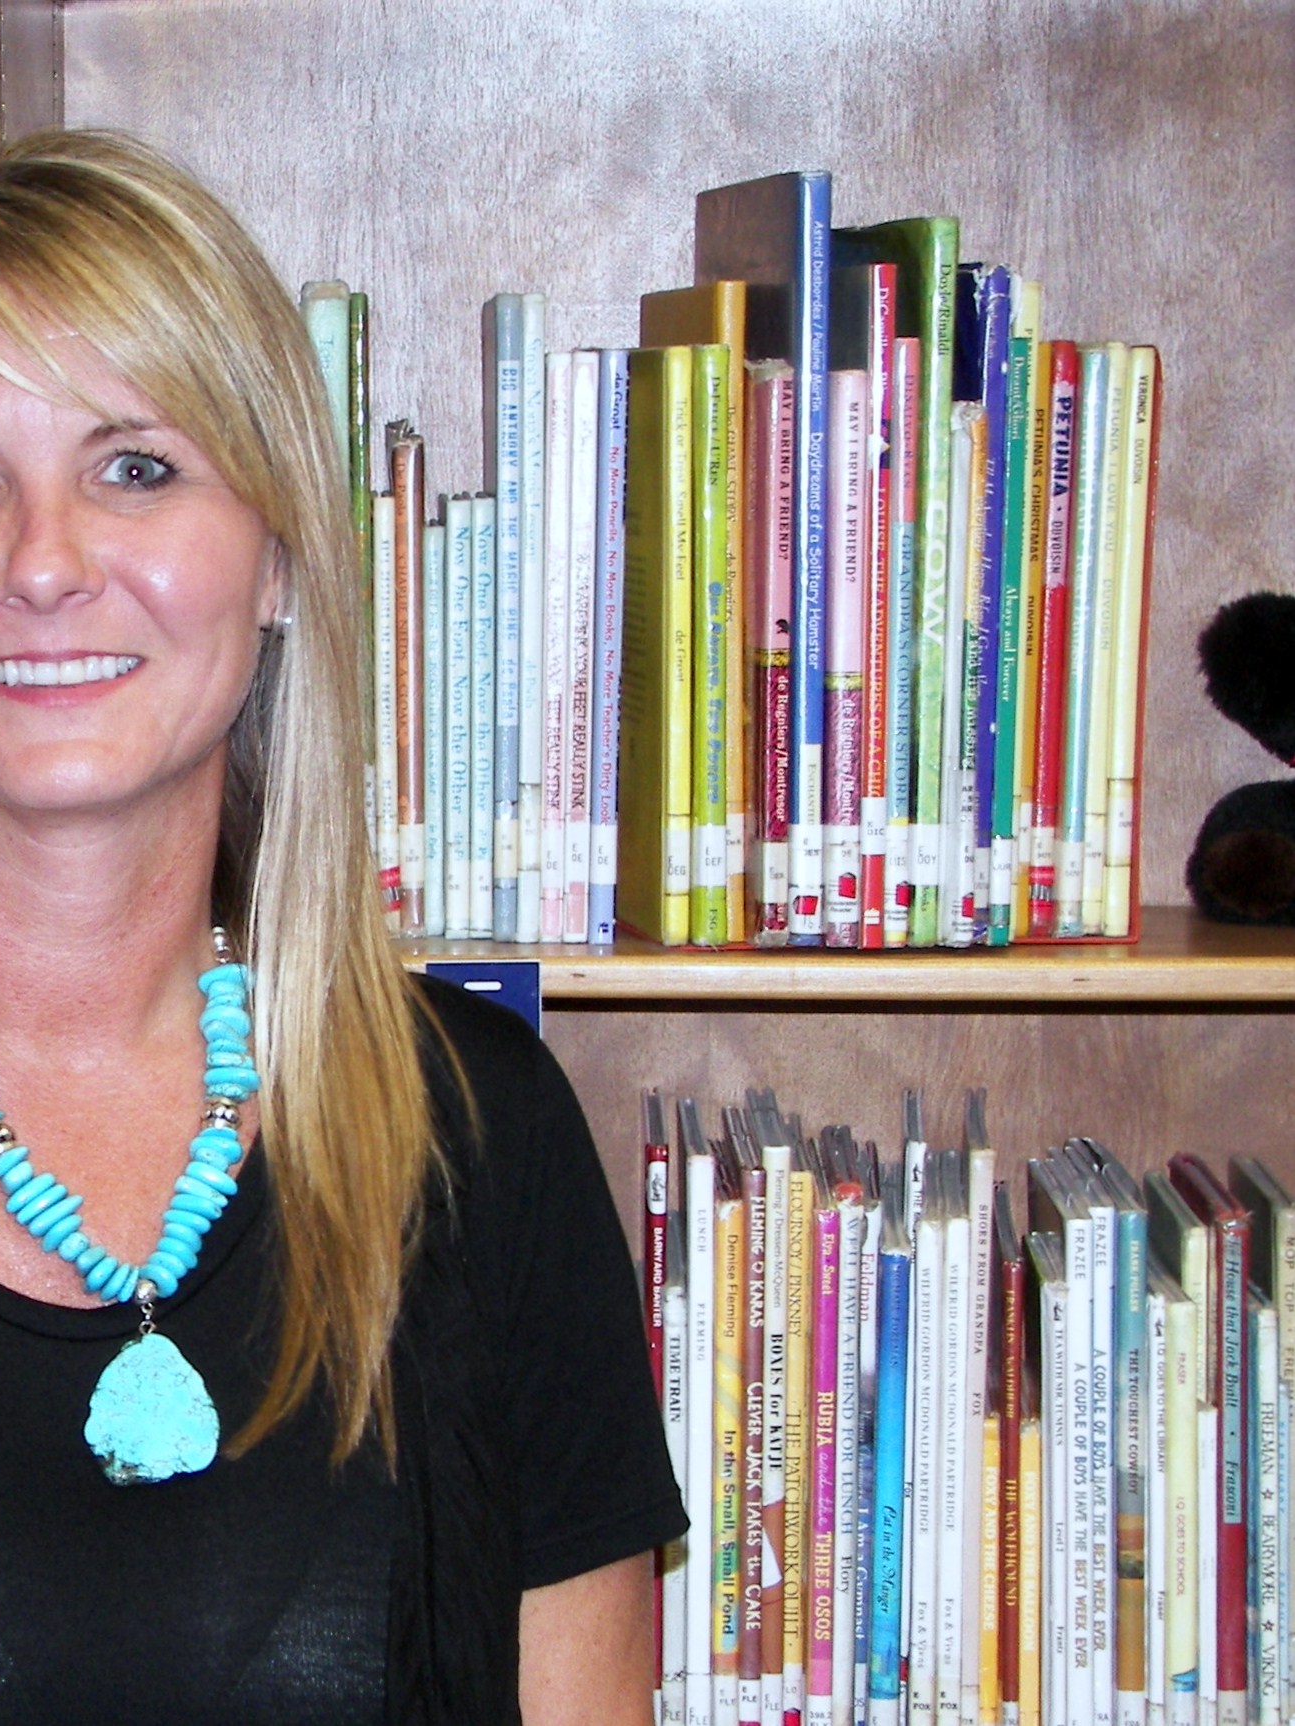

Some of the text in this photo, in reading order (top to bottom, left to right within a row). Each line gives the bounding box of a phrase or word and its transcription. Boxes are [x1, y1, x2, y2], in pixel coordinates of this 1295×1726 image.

[810, 220, 824, 412] Astrid Desbordes Pauline Martin
[937, 263, 953, 356] Doyle/Rinaldi
[779, 429, 791, 475] BRING
[781, 379, 793, 410] MAY
[1136, 375, 1149, 424] VERONICA
[778, 495, 790, 561] FRIEND?
[779, 480, 790, 490] A
[806, 432, 824, 670] Daydreams of a Solitary Hamster
[1048, 396, 1073, 575] PETUNIA DUVOISIN
[598, 447, 620, 825] No More Pencils, No More Books, No More Teacher's Dirty Look
[894, 534, 914, 809] GRANDPA'S CORNER STORE
[1001, 584, 1018, 703] Always and Forever
[775, 675, 789, 822] de Regniers/Montresor
[724, 1234, 739, 1338] Denise Fleming
[749, 1195, 765, 1328] FLEMING KARAS
[669, 1334, 681, 1423] TIME TRAIN
[769, 1333, 784, 1473] BOXES for KATJE
[1127, 1349, 1140, 1495] THE TOUGHEST COWBOY
[1224, 1259, 1240, 1517] House that Jack Built Frasconi
[720, 1430, 736, 1635] In the Small, Small Pond
[744, 1380, 763, 1631] CLEVER JACK TAKES the CAKE
[814, 1390, 834, 1640] RUBIA and the THREE OSOS
[1073, 1362, 1088, 1669] A COUPLE OF BOYS HAVE THE BEST WEEK EVER
[1259, 1401, 1277, 1697] FREEMAN BEARYMORE VIKING
